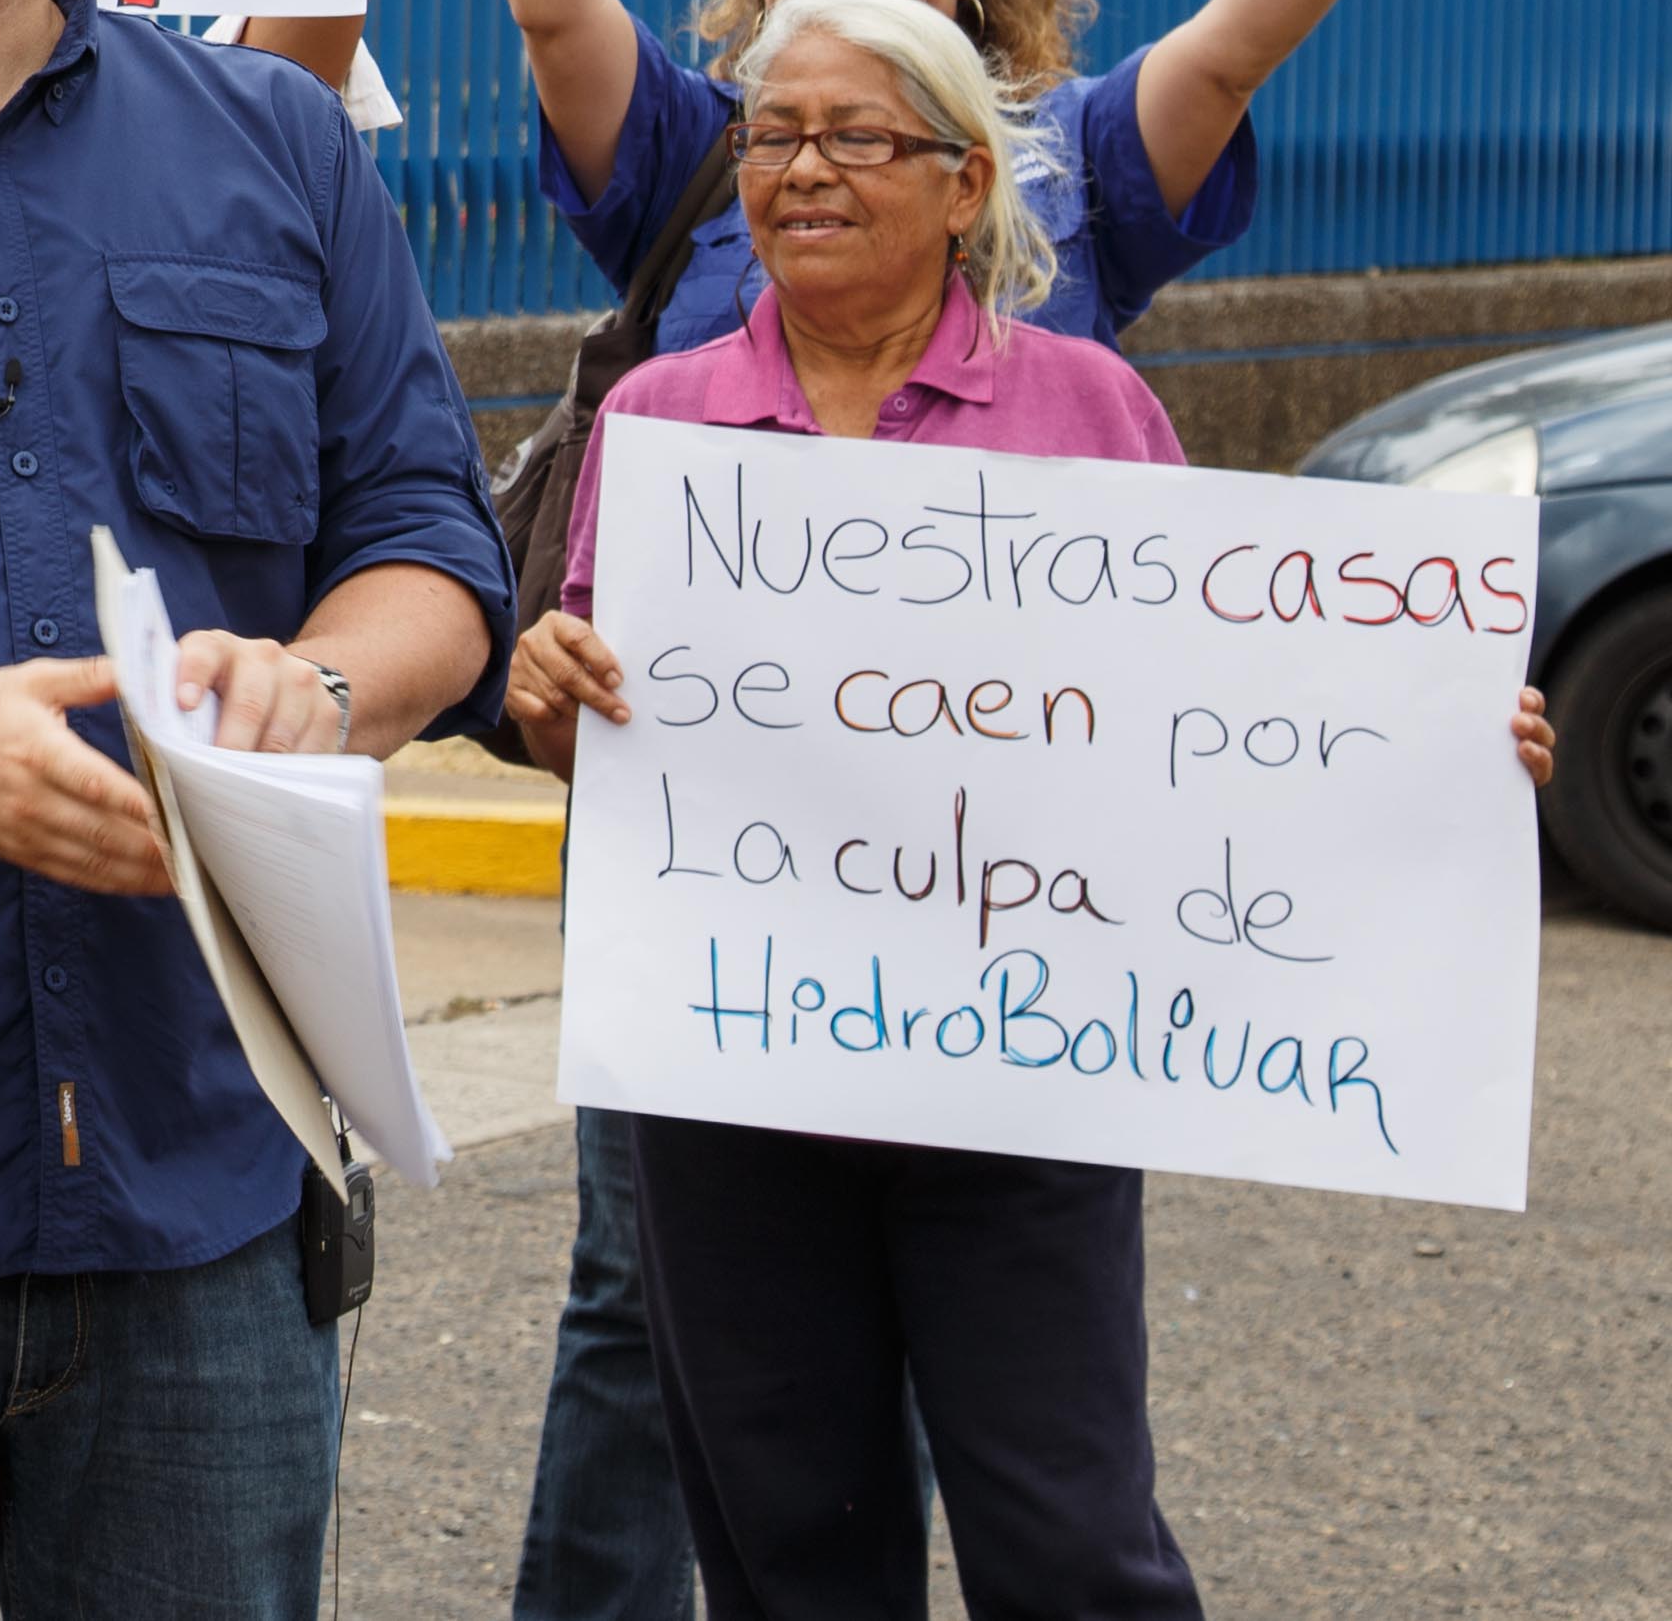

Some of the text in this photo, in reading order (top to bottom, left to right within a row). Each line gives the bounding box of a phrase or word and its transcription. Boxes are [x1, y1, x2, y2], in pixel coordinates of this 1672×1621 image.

[683, 462, 1527, 633] Nuestras casas
[834, 670, 1095, 746] caen
[1170, 708, 1388, 788] por
[658, 772, 1334, 962] La culpa de
